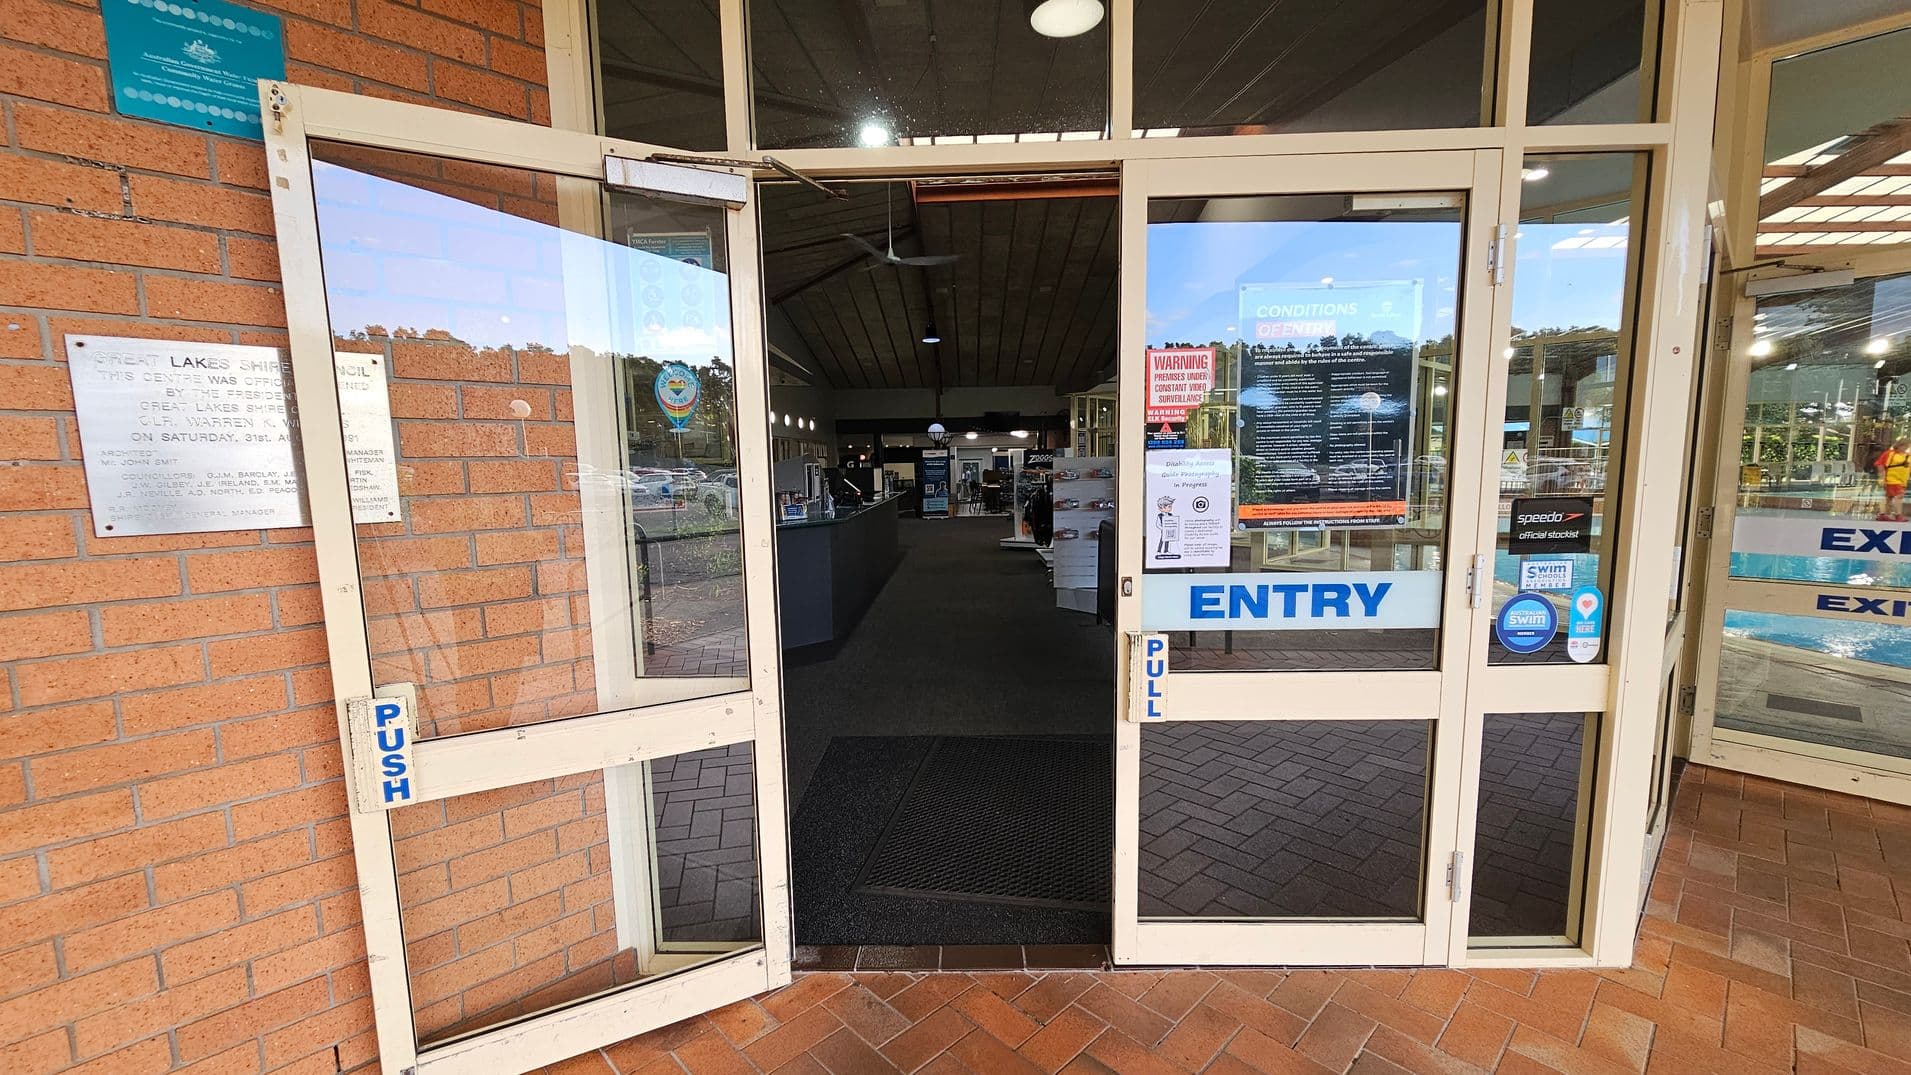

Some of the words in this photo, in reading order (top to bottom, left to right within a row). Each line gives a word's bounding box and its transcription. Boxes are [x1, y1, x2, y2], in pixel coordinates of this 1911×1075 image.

[144, 52, 179, 64] Australian
[180, 60, 222, 75] Government
[161, 66, 202, 80] Community
[202, 74, 223, 86] Water
[1256, 302, 1358, 318] CONDITIONS
[1258, 323, 1282, 337] OF
[1282, 320, 1335, 336] ENTRY
[92, 352, 159, 366] GREAT
[170, 356, 232, 370] LAKES
[240, 360, 292, 374] SHIRE
[1154, 354, 1208, 370] WARNING
[144, 372, 202, 384] CENTRE
[208, 375, 238, 386] WAS
[1154, 373, 1186, 381] PREMISES
[166, 388, 185, 397] BY
[192, 388, 220, 398] THE
[1154, 384, 1187, 392] CONSTANT
[1189, 383, 1207, 391] VIDEO
[1158, 394, 1202, 403] SURVEILLANCE
[140, 401, 188, 412] GREAT
[196, 403, 240, 412] LAKES
[246, 404, 285, 414] SHIRE
[186, 417, 254, 428] WARREN
[131, 432, 153, 442] ON
[1517, 512, 1563, 525] speedo
[1519, 530, 1547, 540] official
[1547, 530, 1579, 539] stockist
[1190, 582, 1392, 619] ENTRY
[1509, 615, 1546, 625] swim
[1146, 640, 1164, 717] PULL
[375, 704, 410, 802] PUSH
